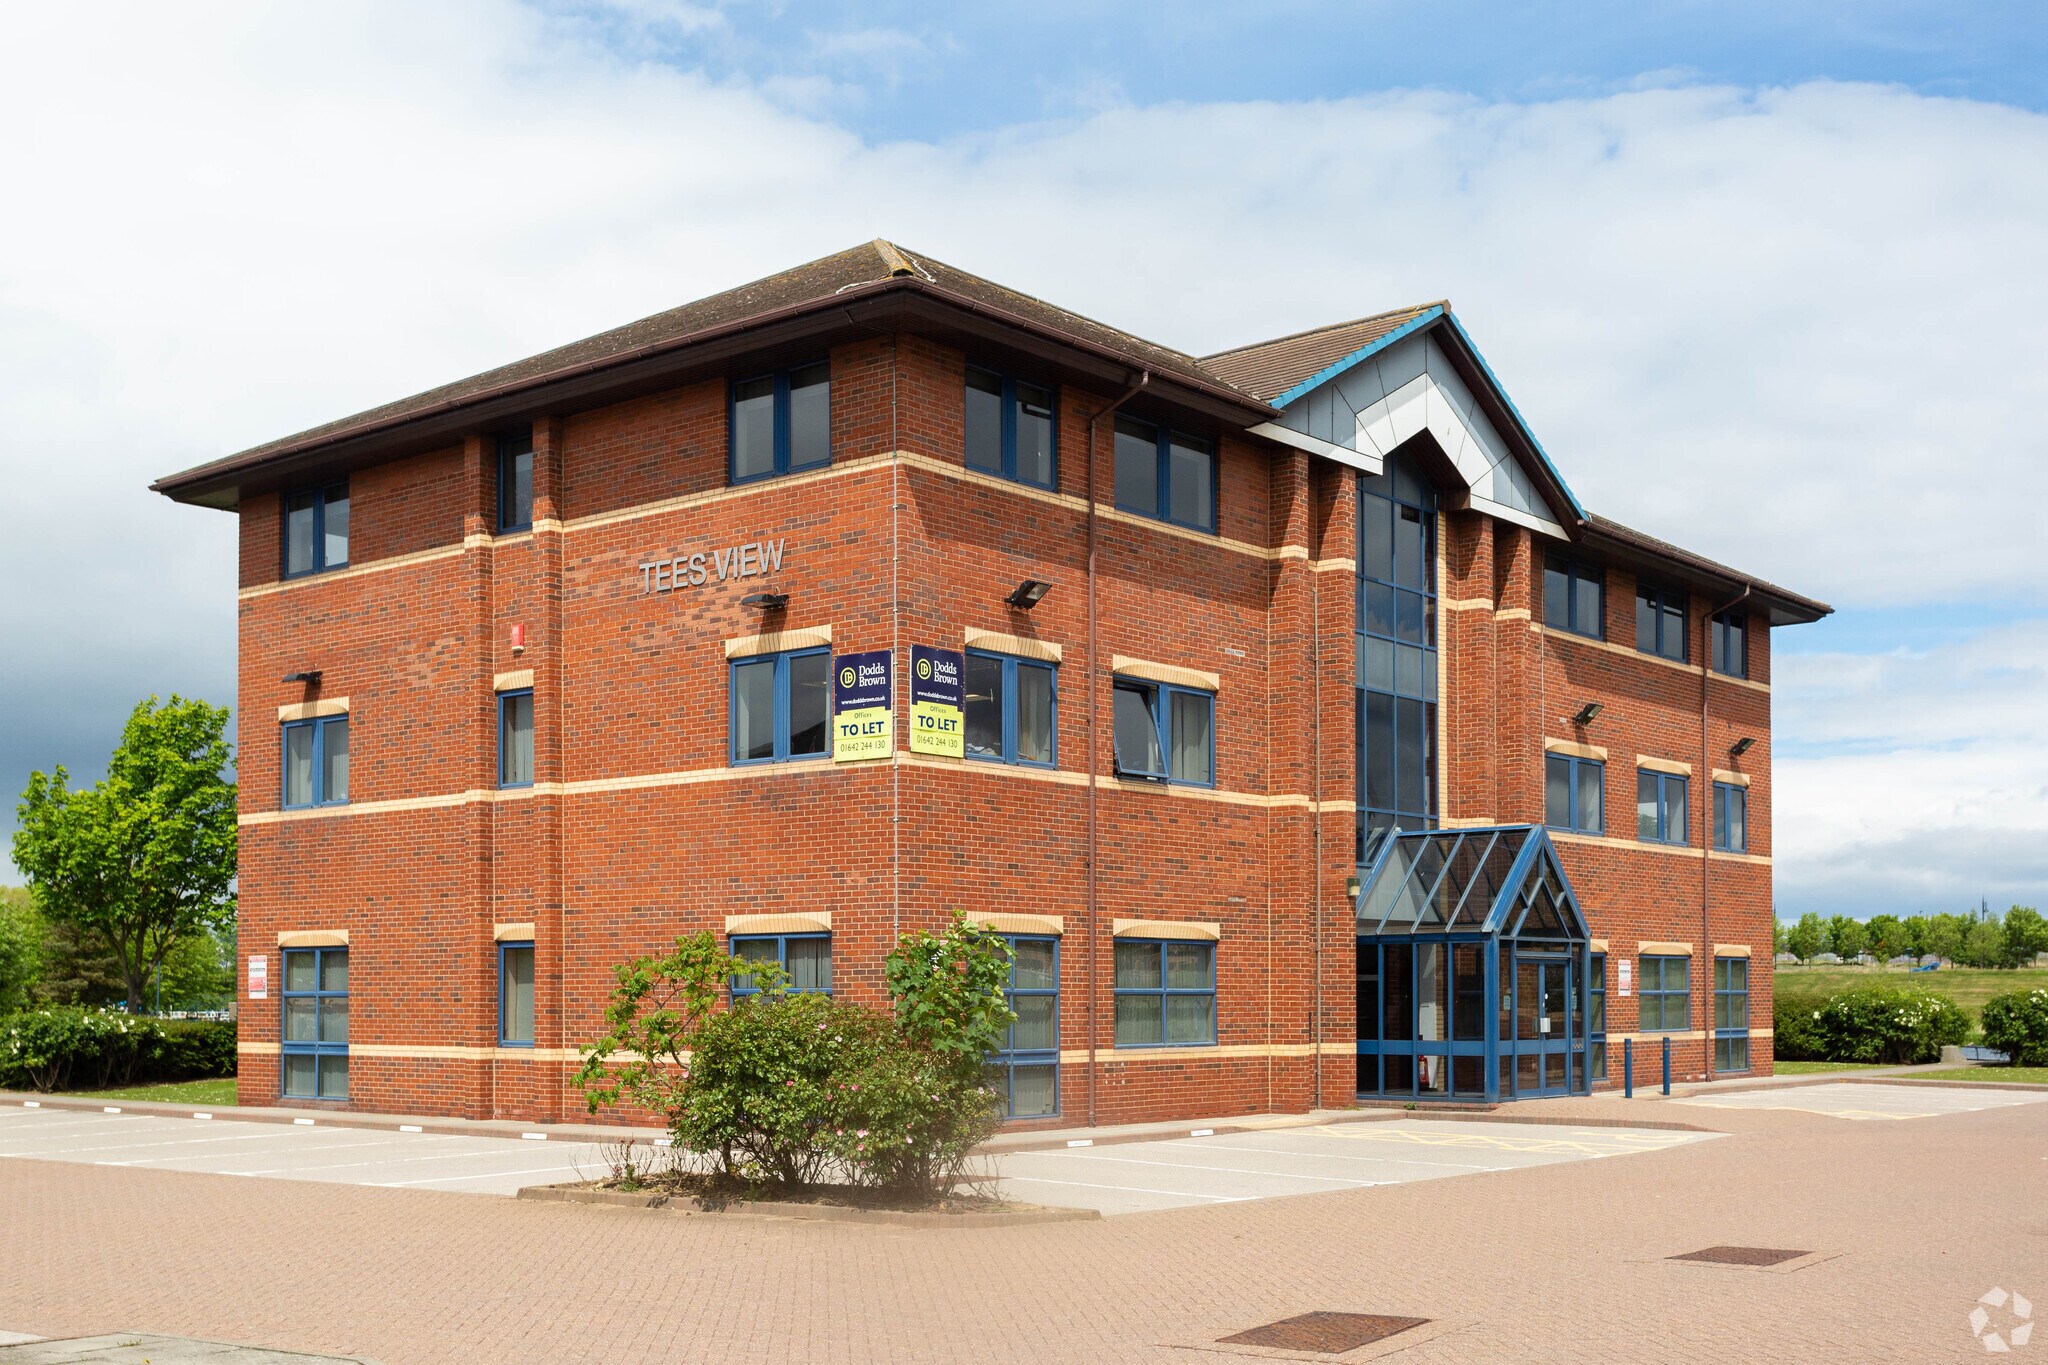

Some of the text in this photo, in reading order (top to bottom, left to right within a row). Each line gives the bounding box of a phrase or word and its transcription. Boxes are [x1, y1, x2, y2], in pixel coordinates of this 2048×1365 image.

[639, 538, 785, 594] TEES VIEW
[859, 662, 884, 676] Dodds
[934, 660, 957, 674] Dodds
[859, 676, 886, 687] Brown
[934, 672, 958, 685] Brown
[841, 721, 884, 736] TO LET
[918, 716, 957, 731] TO LET
[840, 740, 885, 752] 01642 244 130
[917, 735, 957, 748] 01642 244 130
